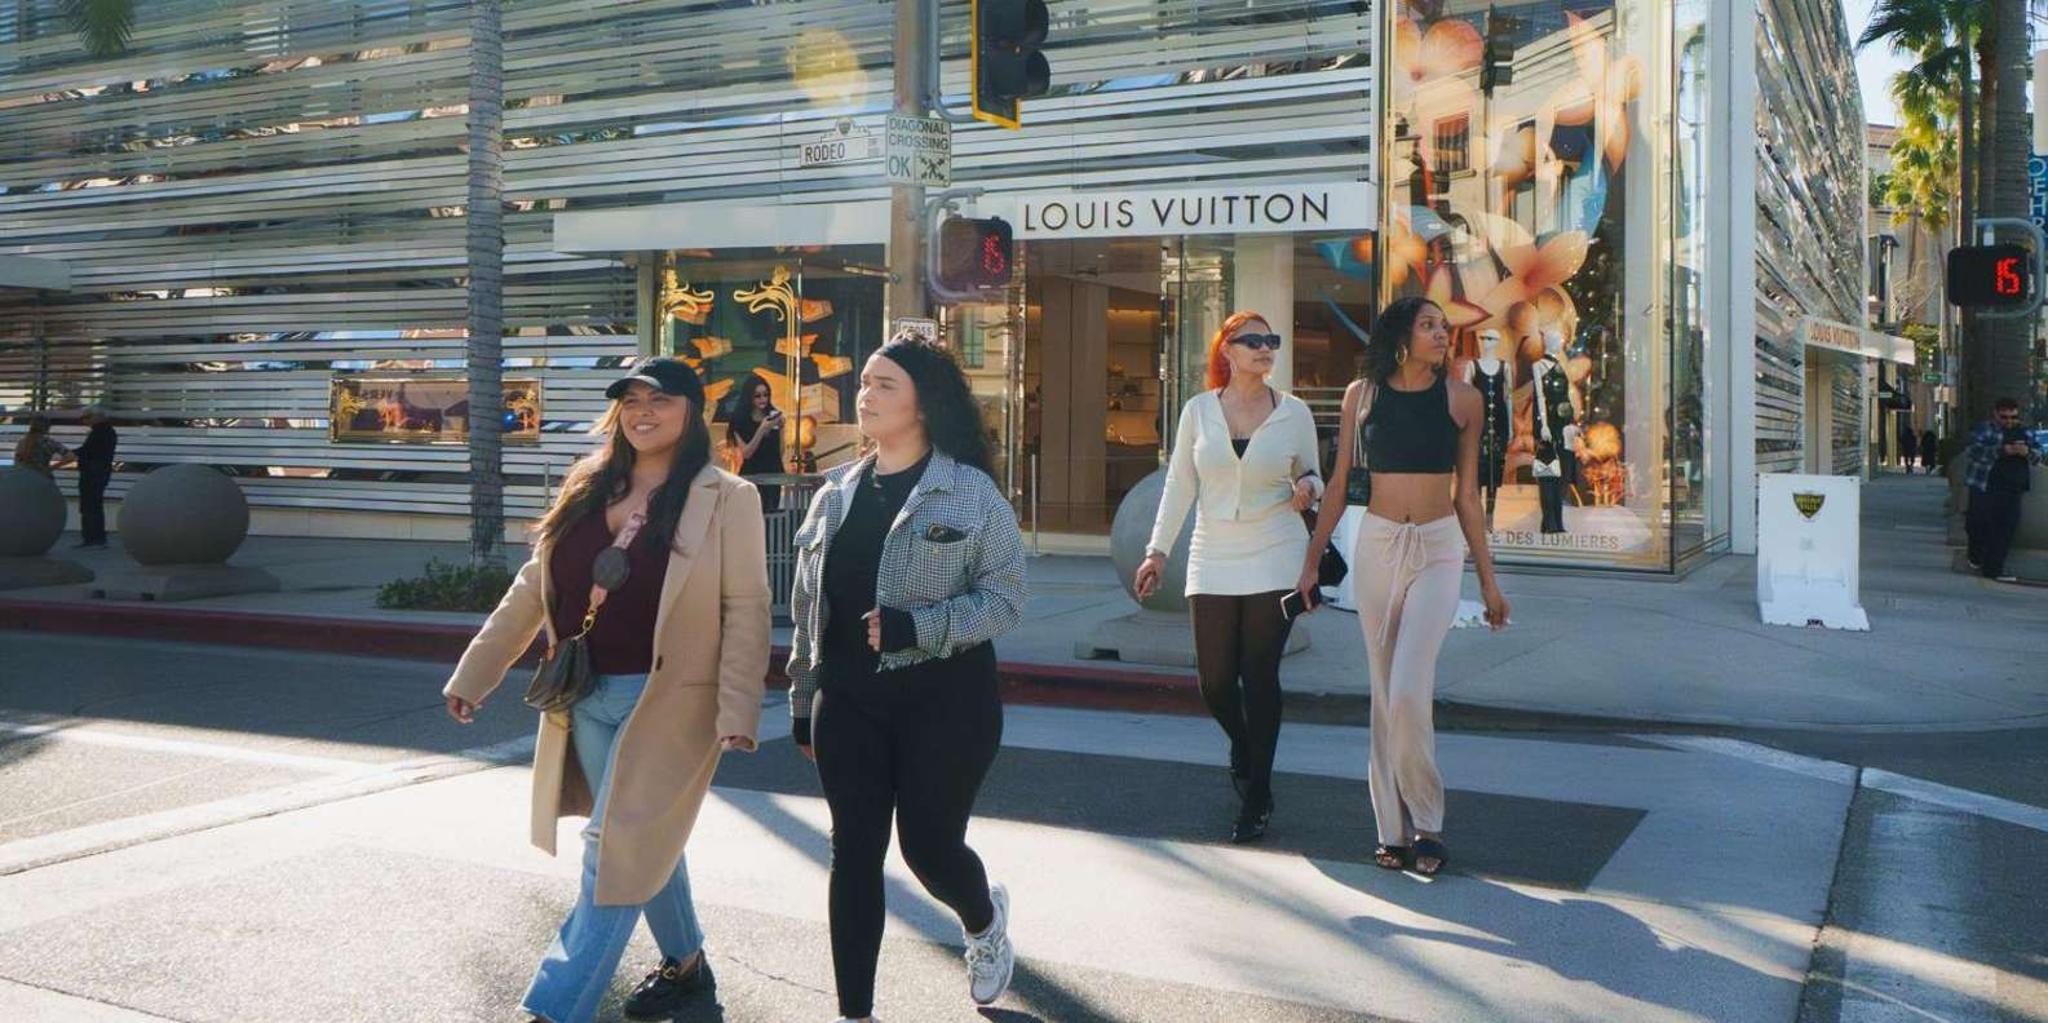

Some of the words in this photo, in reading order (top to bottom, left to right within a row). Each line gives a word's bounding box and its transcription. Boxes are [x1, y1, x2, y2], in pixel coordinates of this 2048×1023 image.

[889, 119, 947, 134] DIAGONAL
[889, 133, 948, 150] CROSSING
[804, 142, 846, 162] RODEO
[889, 156, 910, 177] OK
[1024, 199, 1135, 231] LOUIS
[1151, 192, 1329, 228] VUITTON
[1506, 531, 1534, 546] DES
[1541, 531, 1619, 549] LUMIERES
